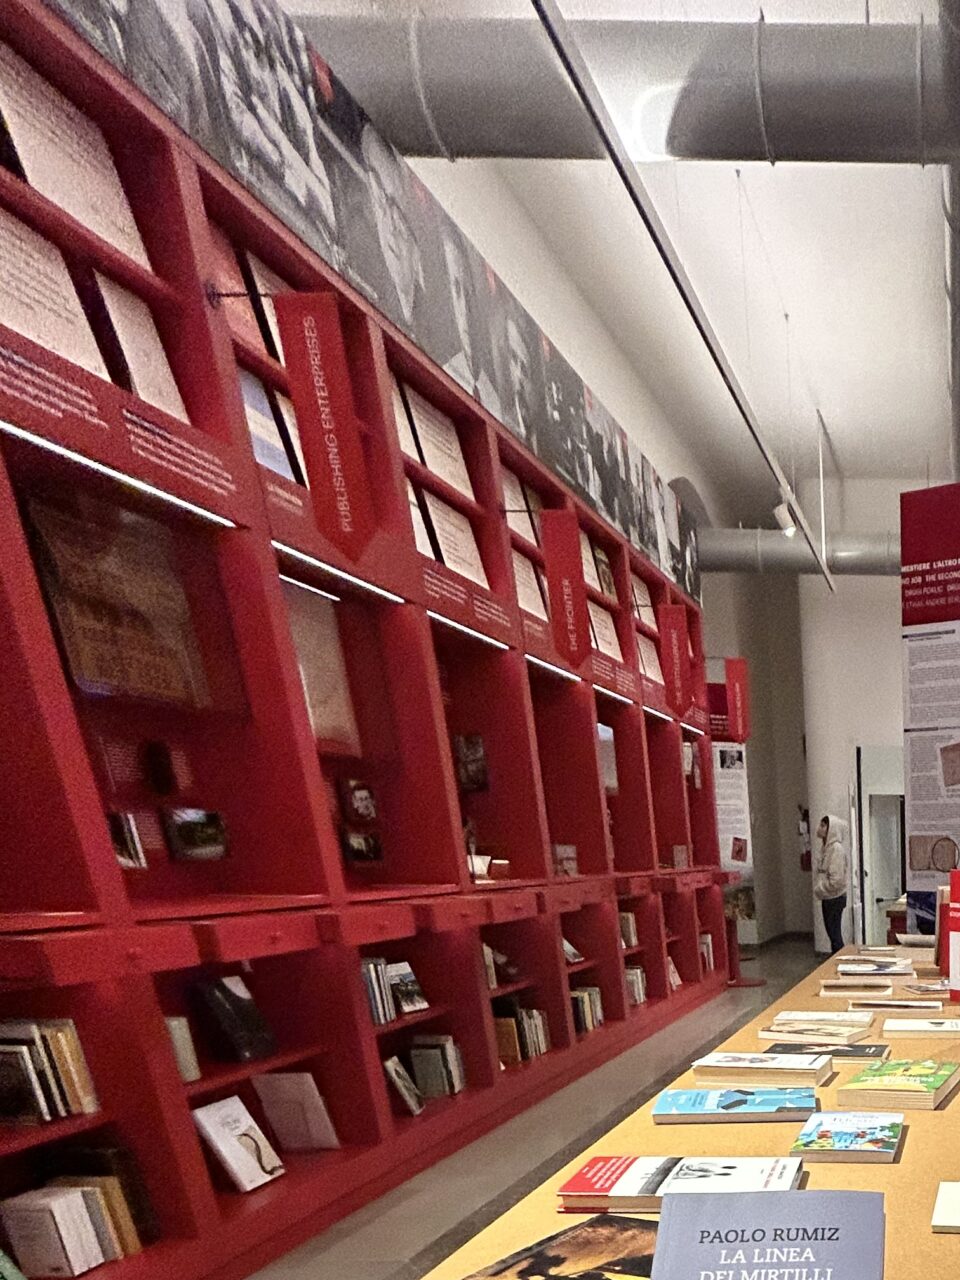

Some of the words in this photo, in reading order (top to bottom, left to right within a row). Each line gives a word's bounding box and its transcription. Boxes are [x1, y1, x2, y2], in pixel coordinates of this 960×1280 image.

[303, 316, 334, 429] ENTERPRISES
[324, 433, 353, 533] PUBLISHING
[562, 578, 576, 631] FRONTIER
[698, 1228, 766, 1244] PAOLO
[772, 1227, 840, 1242] RUMIZ
[720, 1249, 747, 1265] LA
[753, 1248, 816, 1263] LINEA
